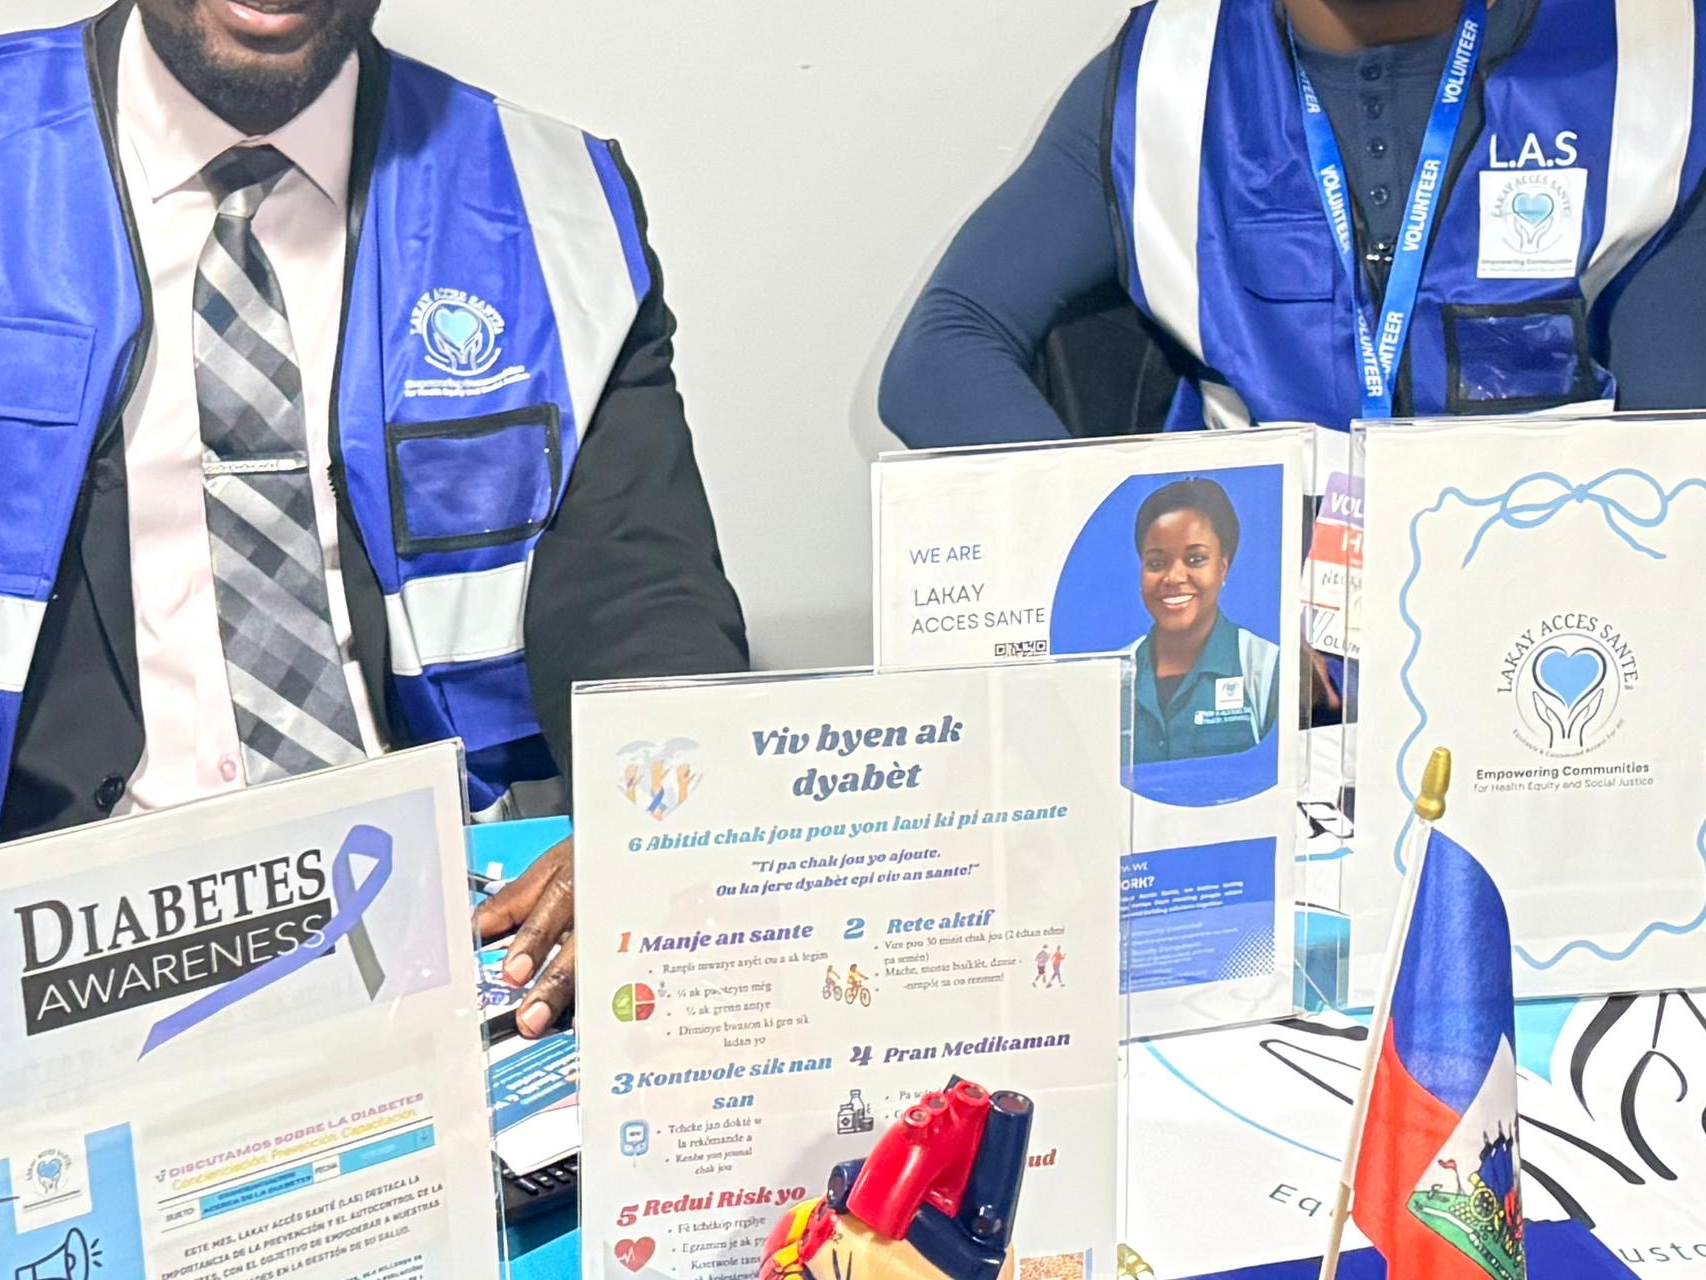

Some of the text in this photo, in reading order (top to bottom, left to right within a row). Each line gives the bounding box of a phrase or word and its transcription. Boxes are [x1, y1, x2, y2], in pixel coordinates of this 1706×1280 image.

[1441, 19, 1478, 104] VOLUNTEER
[1489, 130, 1578, 168] L.A.S
[1400, 158, 1442, 253] VOLUNTEER
[909, 544, 982, 565] WE ARE
[914, 583, 985, 607] LAKAY
[911, 607, 1046, 635] ACCES SANTE
[1497, 613, 1639, 694] LAKAY ACCES SANTE
[753, 714, 962, 756] Viv byen ak
[792, 761, 920, 799] dyabèt
[1476, 762, 1650, 781] Empowering Communities
[1562, 779, 1582, 789] and
[1585, 778, 1616, 789] Social
[1619, 776, 1654, 788] Justice
[627, 805, 1067, 852] 6 Abitid chak jou pou yon lavi ki pi an sante
[775, 860, 796, 874] pa
[799, 854, 838, 869] chak
[838, 853, 865, 869] jou
[866, 853, 886, 866] yo
[902, 870, 922, 880] an
[1120, 875, 1156, 891] ORK?
[843, 917, 865, 939] 2
[886, 908, 995, 934] Rete aktif
[616, 930, 631, 953] 1
[639, 924, 813, 952] Manje an sante
[36, 914, 327, 1019] AWARENESS
[849, 1045, 872, 1066] 4
[883, 1033, 1070, 1063] Pran Medikaman
[610, 1072, 634, 1095] 3
[637, 1057, 832, 1087] Kontwole sik nan
[712, 1094, 754, 1109] san
[643, 1186, 810, 1216] Redui Risk yo
[616, 1203, 639, 1227] 5
